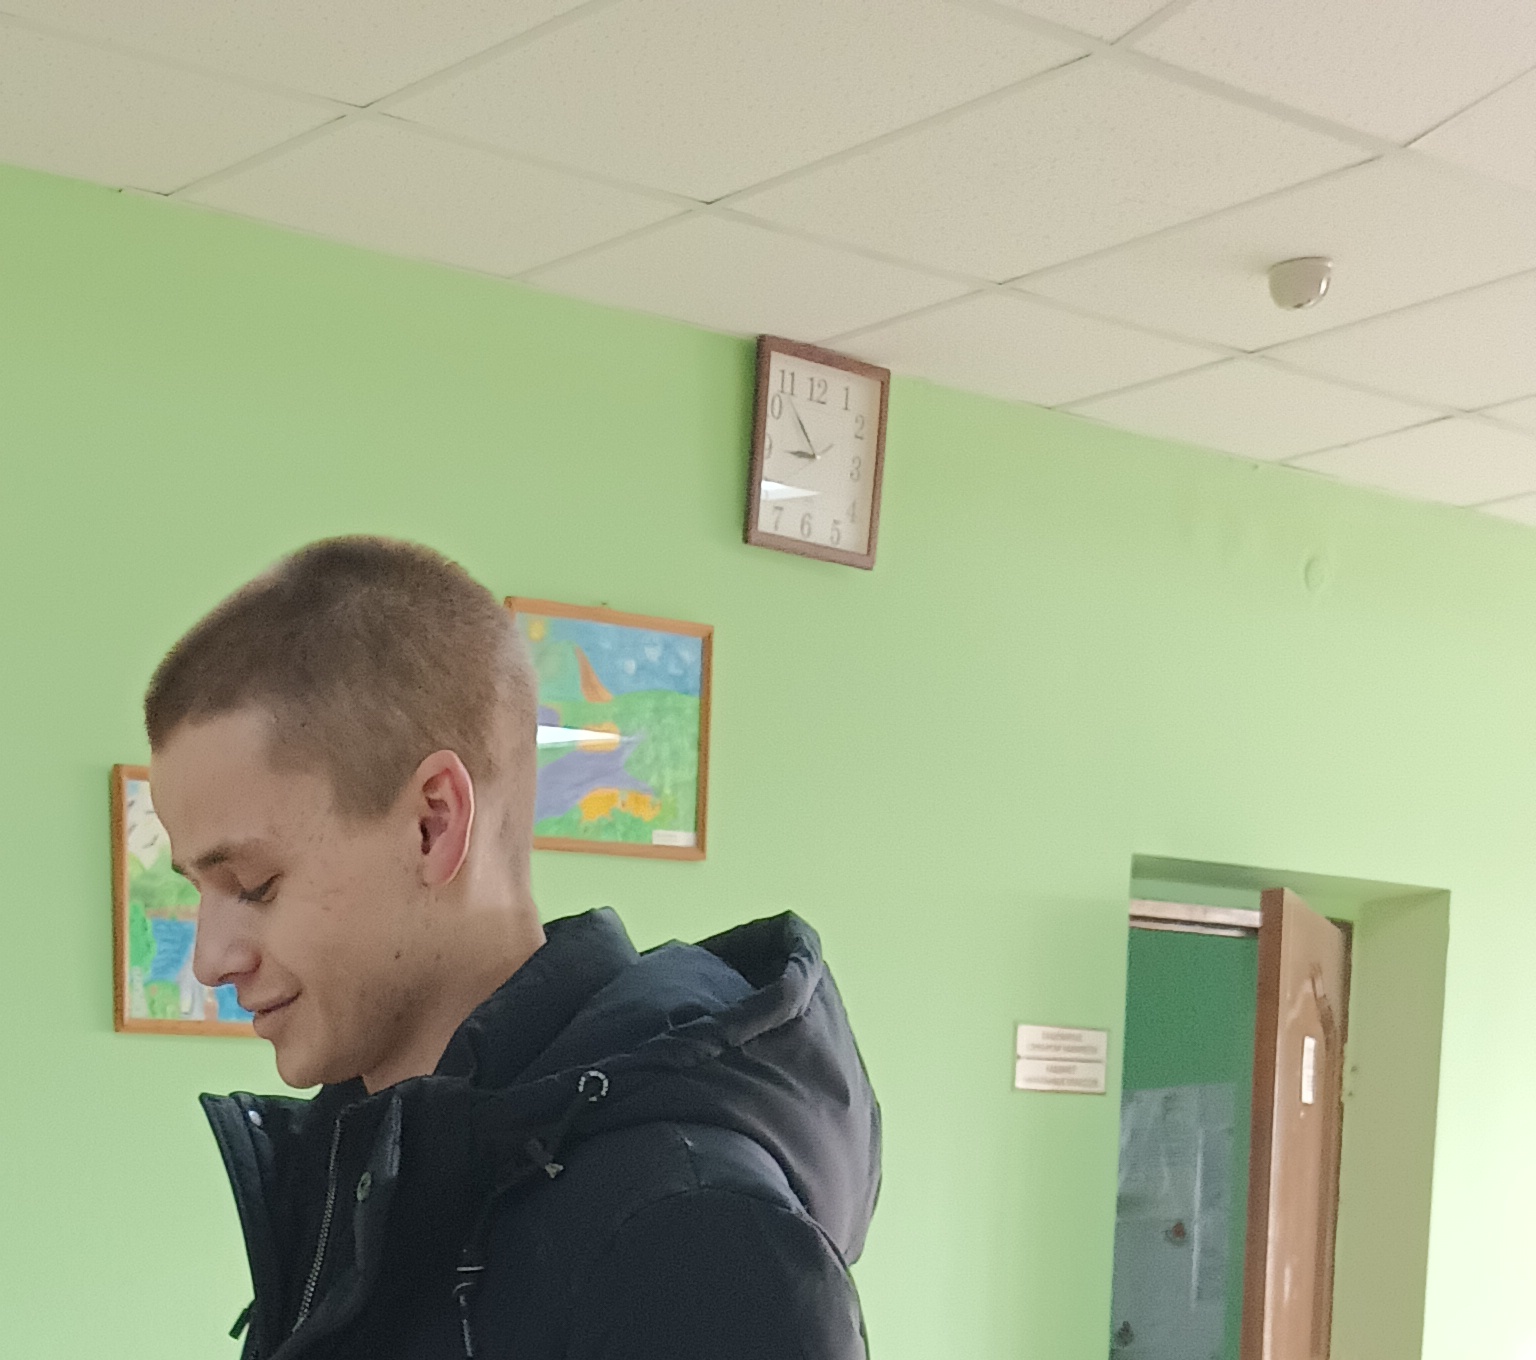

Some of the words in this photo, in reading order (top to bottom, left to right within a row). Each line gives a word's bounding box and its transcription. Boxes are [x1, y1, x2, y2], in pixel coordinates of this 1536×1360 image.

[779, 369, 796, 396] 11
[808, 377, 829, 405] 12
[842, 386, 851, 411] 1
[854, 414, 865, 440] 2
[849, 456, 862, 482] 3
[772, 506, 784, 532] 7
[800, 512, 813, 540] 6
[829, 519, 842, 546] 5
